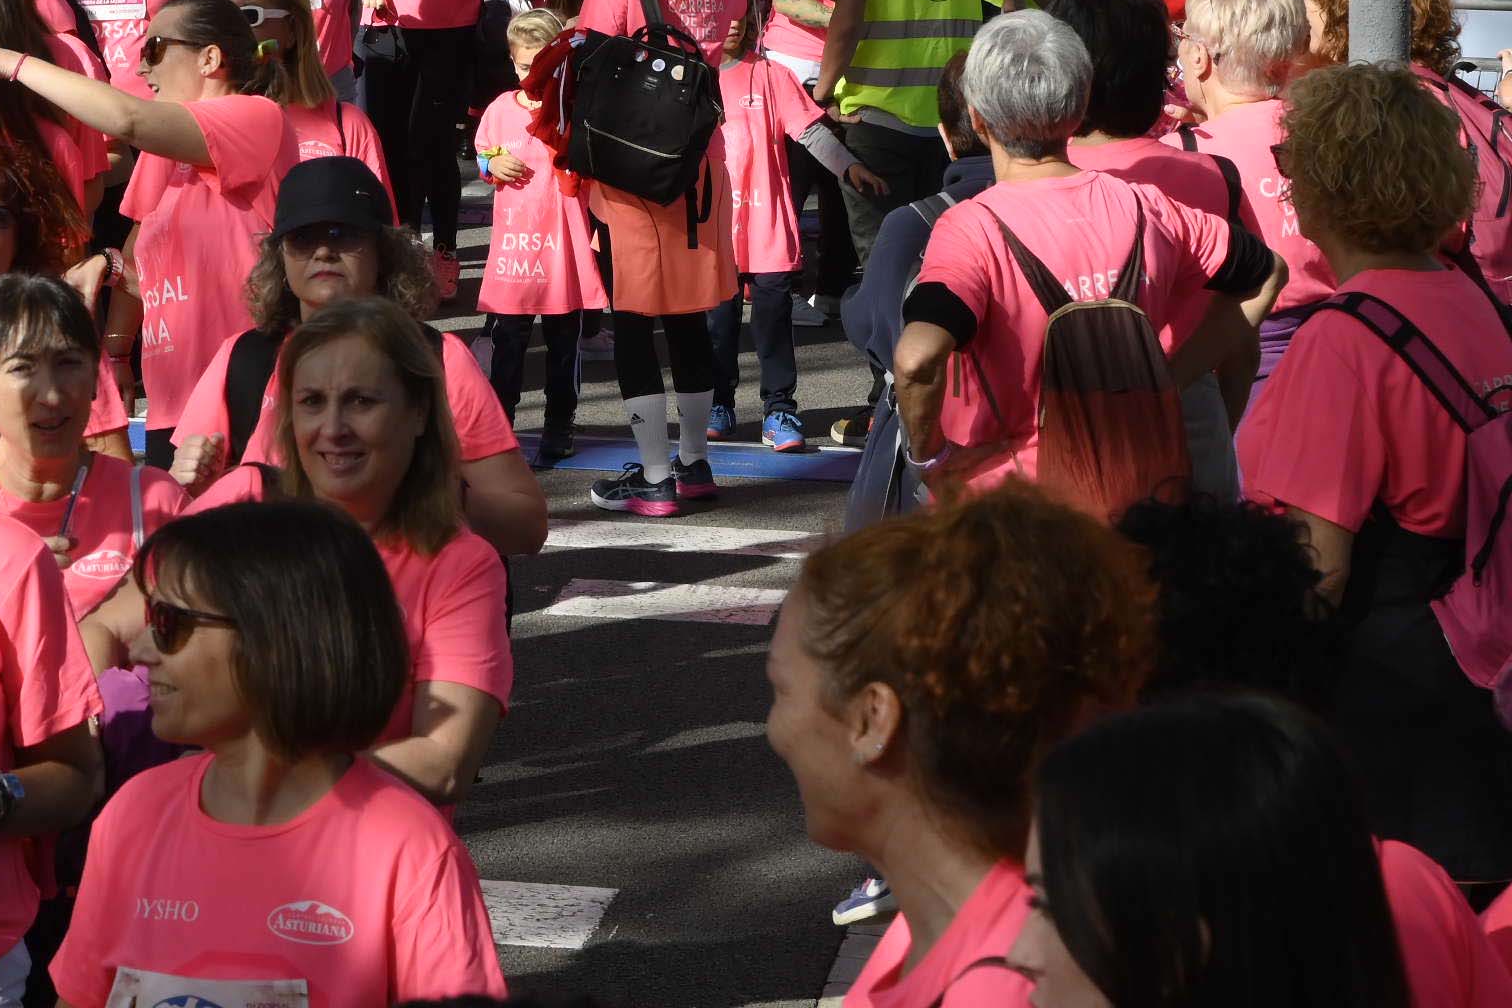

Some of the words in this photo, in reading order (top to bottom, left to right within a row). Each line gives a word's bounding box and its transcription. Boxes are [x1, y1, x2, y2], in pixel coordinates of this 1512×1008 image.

[668, 0, 725, 13] CARRERA
[681, 13, 698, 26] DE
[142, 316, 172, 349] MA
[273, 914, 347, 939] ASTURIANA
